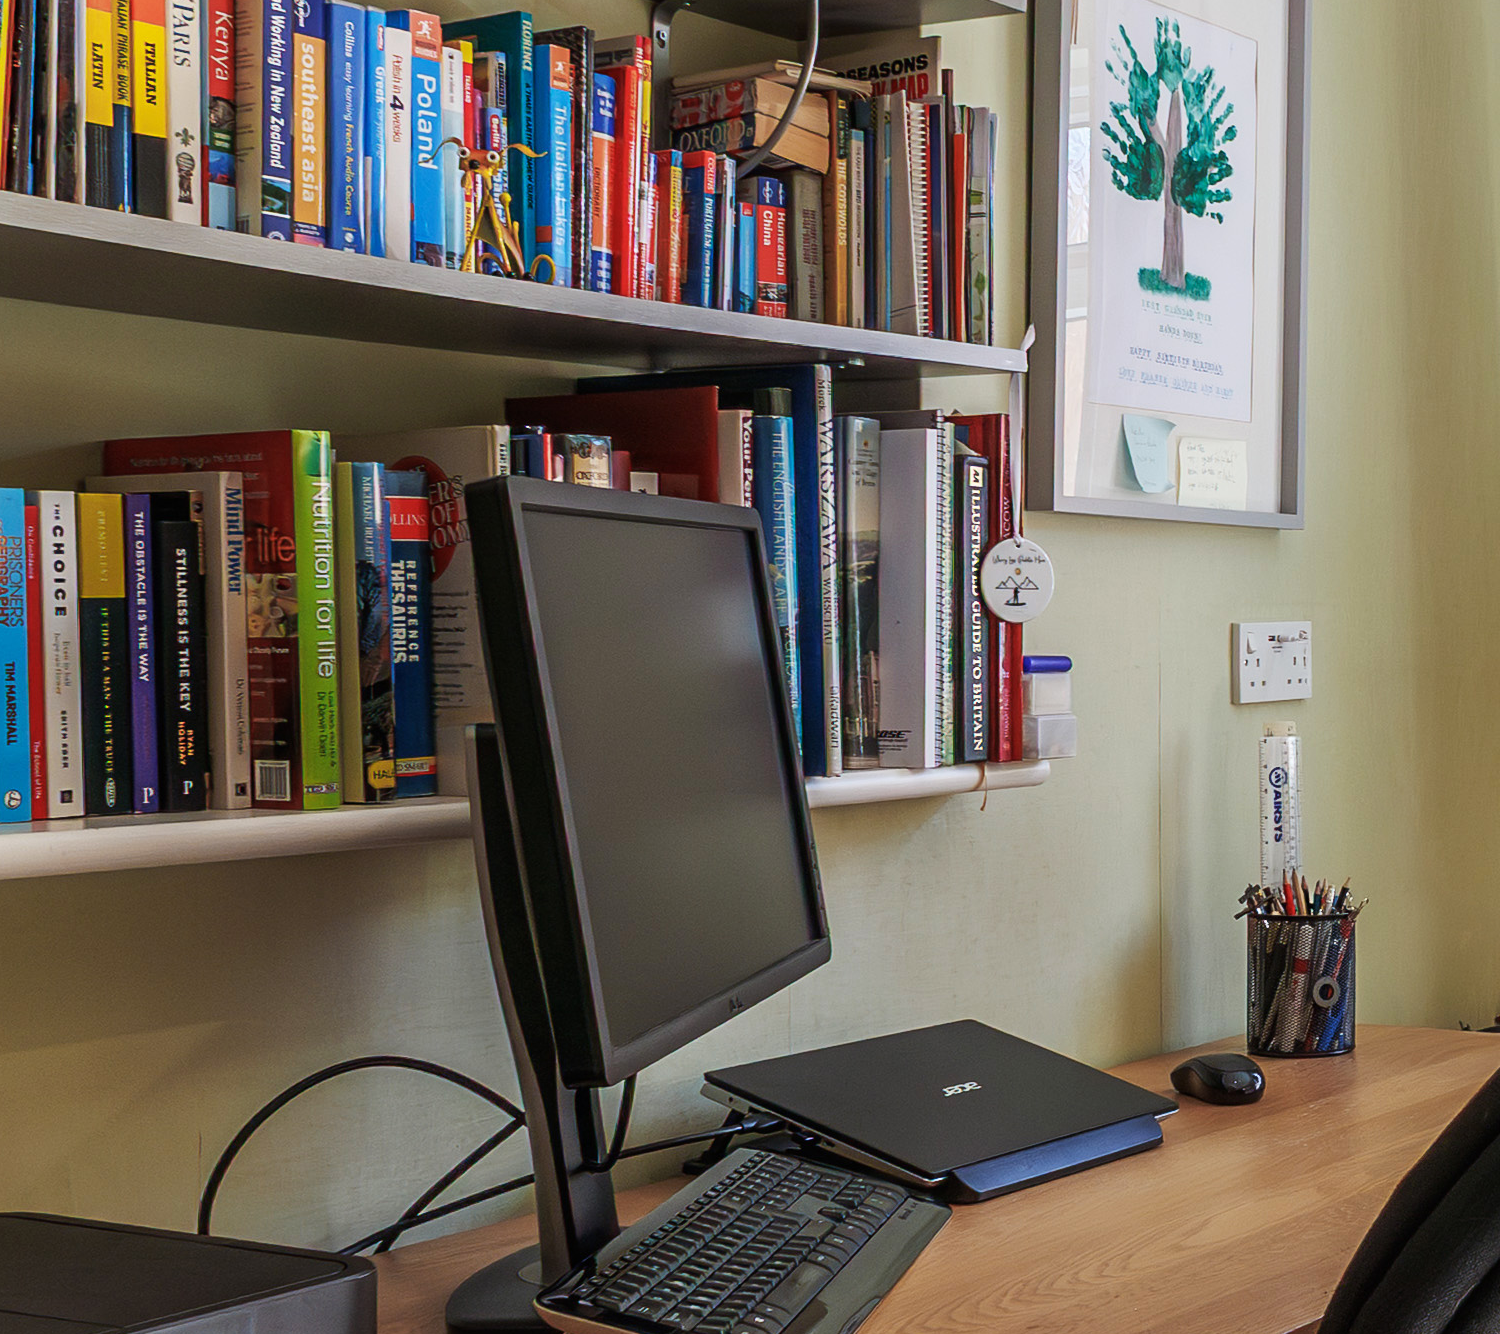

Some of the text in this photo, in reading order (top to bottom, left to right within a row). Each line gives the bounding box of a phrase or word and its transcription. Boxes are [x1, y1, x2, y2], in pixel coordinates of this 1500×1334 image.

[91, 42, 104, 90] LATIN
[170, 0, 196, 67] PARIS
[211, 10, 234, 80] Kenya
[266, 14, 286, 66] Working
[522, 20, 532, 71] FLORENCE
[145, 42, 157, 106] ITALIAN
[270, 69, 286, 82] in
[270, 85, 285, 113] New
[269, 115, 285, 169] Zealand
[300, 42, 320, 203] southeast asia
[344, 21, 355, 216] Collins easy learning French Audio Course
[416, 73, 439, 170] Poland
[763, 210, 773, 246] China
[818, 417, 837, 569] WARSZAWA
[225, 487, 244, 596] Mind Power
[256, 524, 296, 564] life
[311, 481, 336, 679] Nutrition for life
[8, 535, 25, 627] PRISONERS
[134, 511, 150, 682] THE OBSTACLE IS THE WAY
[391, 559, 407, 664] THESAURUS
[406, 559, 419, 663] REFERENCE
[176, 547, 191, 712] STILLNESS IS THE KEY
[4, 660, 17, 745] TIM MARSHALL
[177, 720, 187, 765] HOLIDAY
